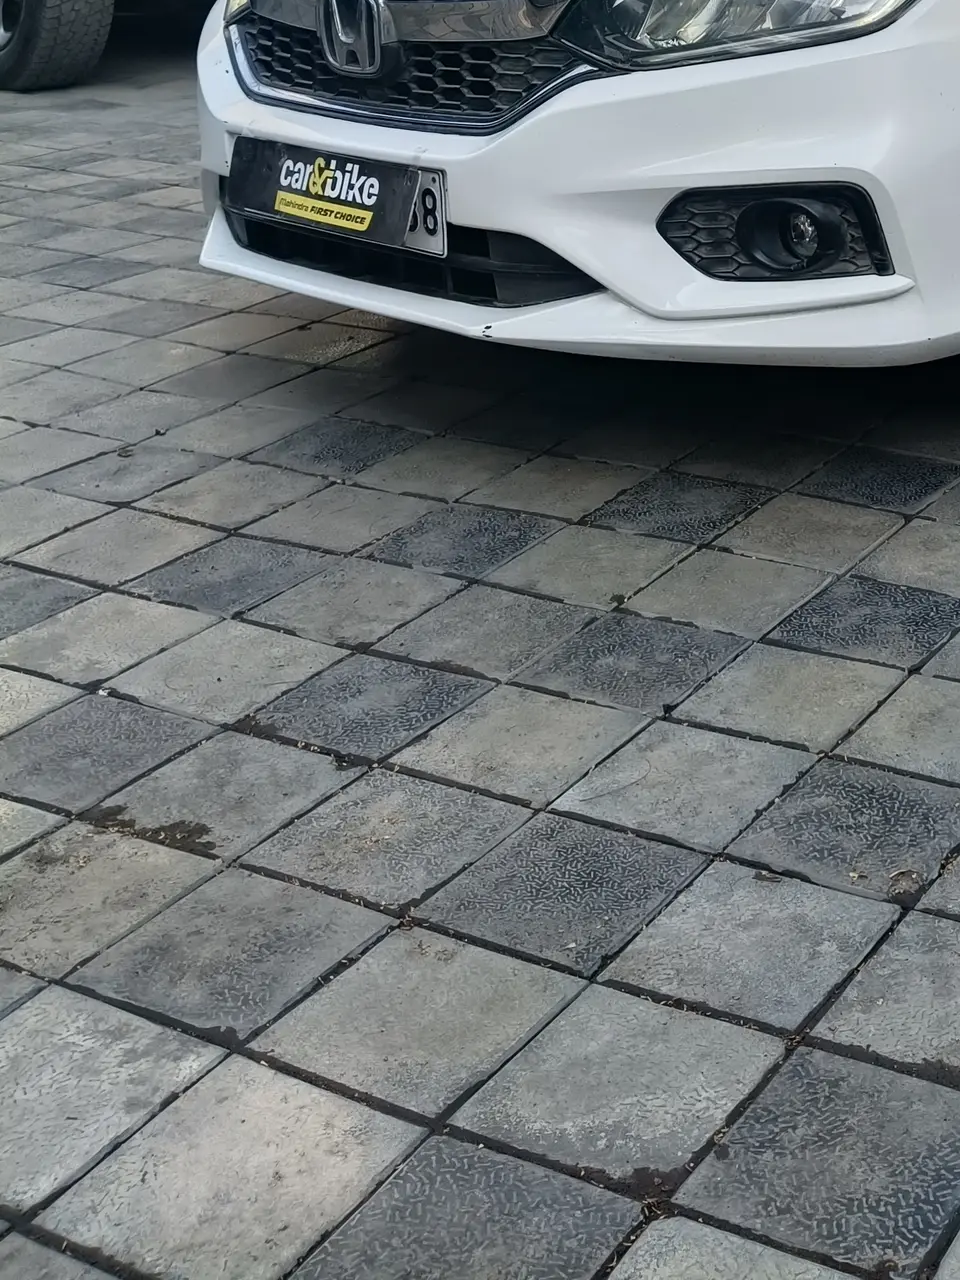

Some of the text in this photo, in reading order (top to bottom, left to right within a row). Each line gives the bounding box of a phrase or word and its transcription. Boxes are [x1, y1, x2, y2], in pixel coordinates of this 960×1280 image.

[279, 157, 380, 206] car&bike
[280, 198, 367, 225] Mahindra FIRST CHOICE
